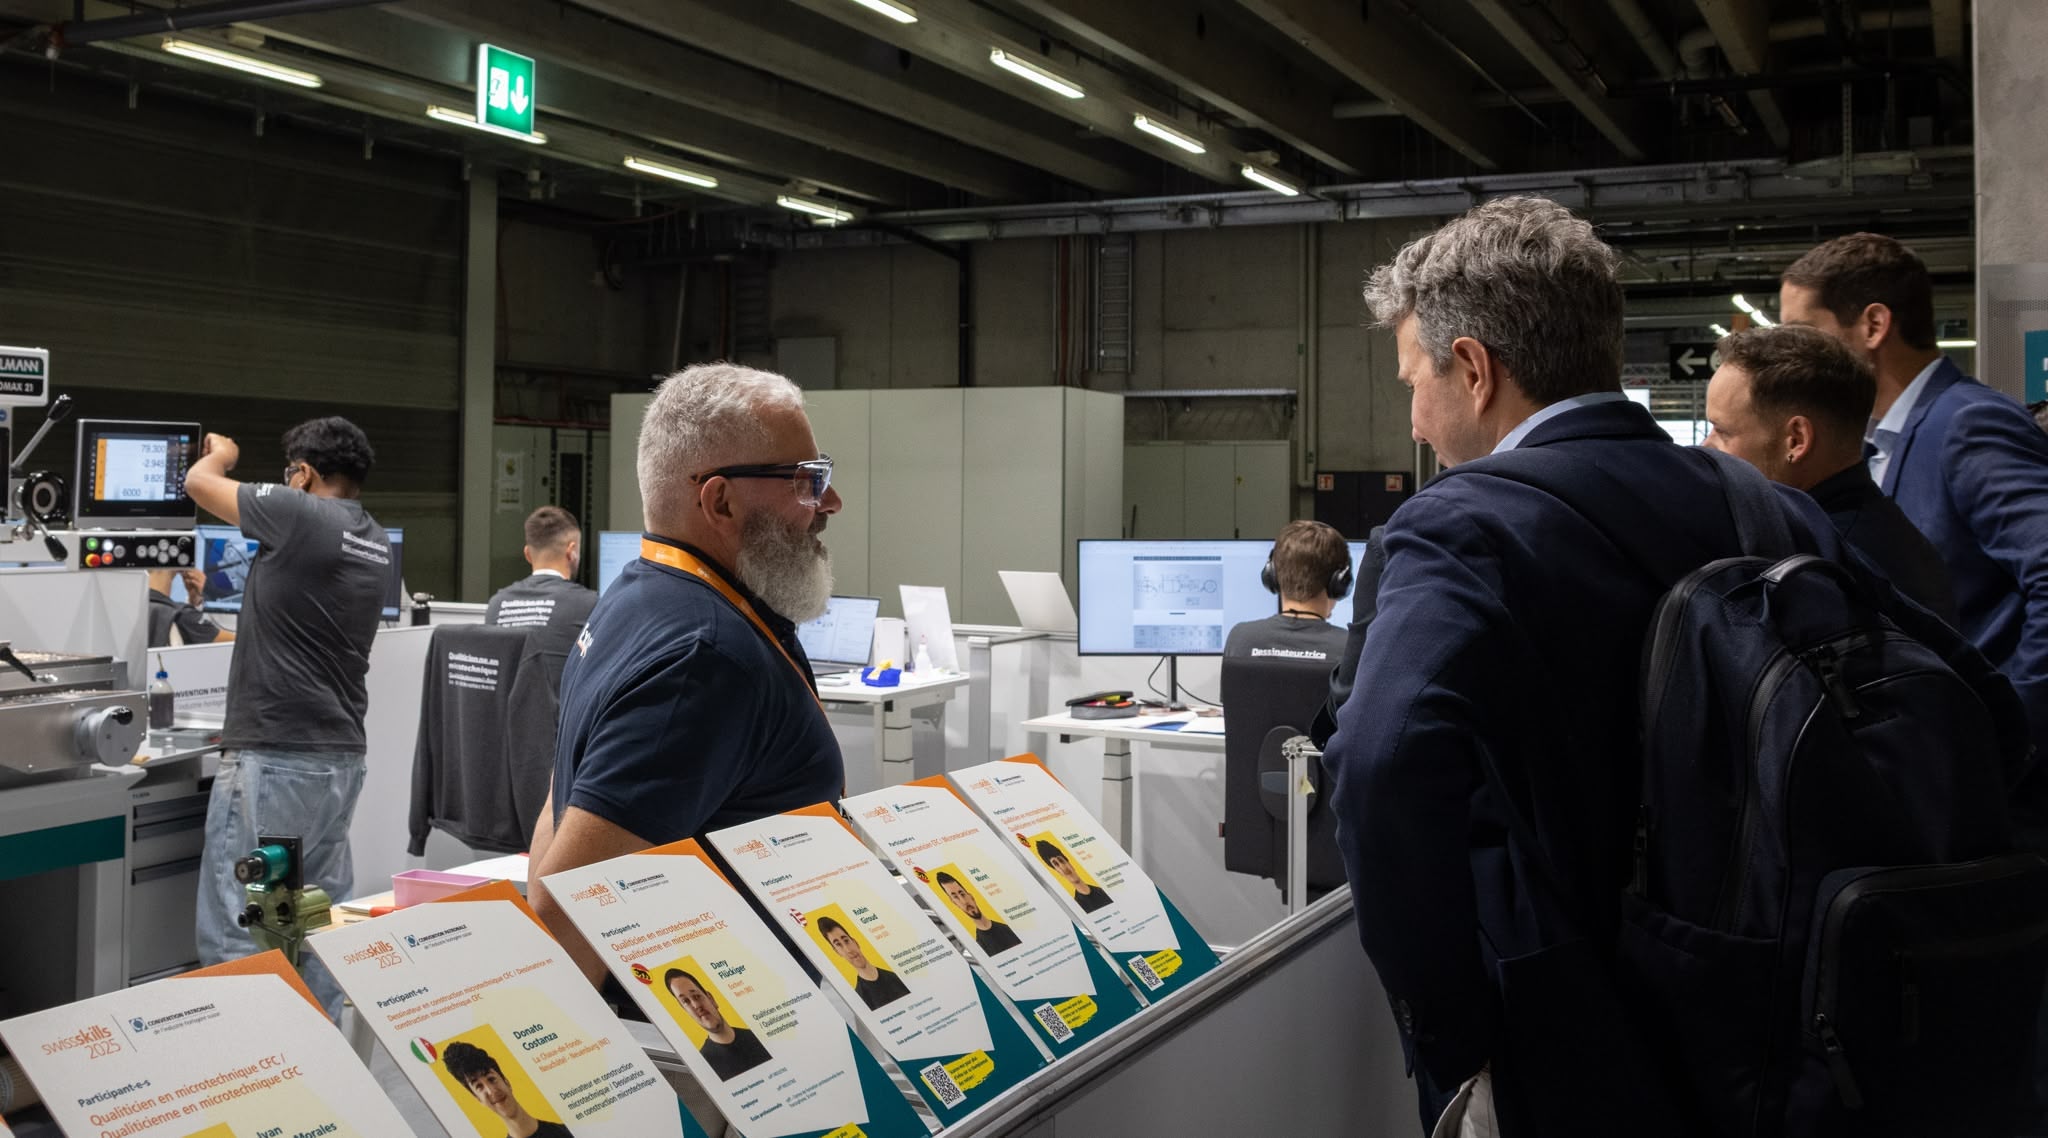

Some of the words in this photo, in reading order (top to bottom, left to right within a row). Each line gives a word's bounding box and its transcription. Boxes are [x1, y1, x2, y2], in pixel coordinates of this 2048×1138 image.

[24, 383, 34, 392] 21
[646, 932, 656, 940] en
[656, 918, 701, 937] microtechnique
[700, 912, 712, 921] CFC
[662, 940, 672, 948] en
[672, 925, 716, 945] microtechnique
[715, 920, 728, 930] CFC
[375, 952, 402, 968] 2025
[710, 960, 728, 970] Dany
[148, 1013, 184, 1026] CONVENTION
[184, 1003, 215, 1016] PATRONALE
[513, 1023, 543, 1039] Donato
[522, 1032, 558, 1051] Costanza
[85, 1038, 121, 1060] 2025
[90, 1097, 157, 1127] Qualiticien
[158, 1092, 174, 1104] en
[175, 1063, 258, 1099] microtechnique
[258, 1055, 280, 1070] CFC
[560, 1081, 593, 1100] Dessinateur
[593, 1077, 602, 1085] en
[601, 1062, 634, 1081] construction
[78, 1079, 151, 1108] Participant-e-s
[101, 1109, 181, 1138] Qualiticienne
[182, 1103, 198, 1116] en
[199, 1075, 282, 1109] microtechnique
[281, 1066, 303, 1080] CFC
[568, 1086, 610, 1110] microtechnique
[576, 1112, 584, 1120] en
[584, 1096, 617, 1116] construction
[617, 1077, 657, 1099] microtechnique
[293, 1123, 337, 1138] Morales
